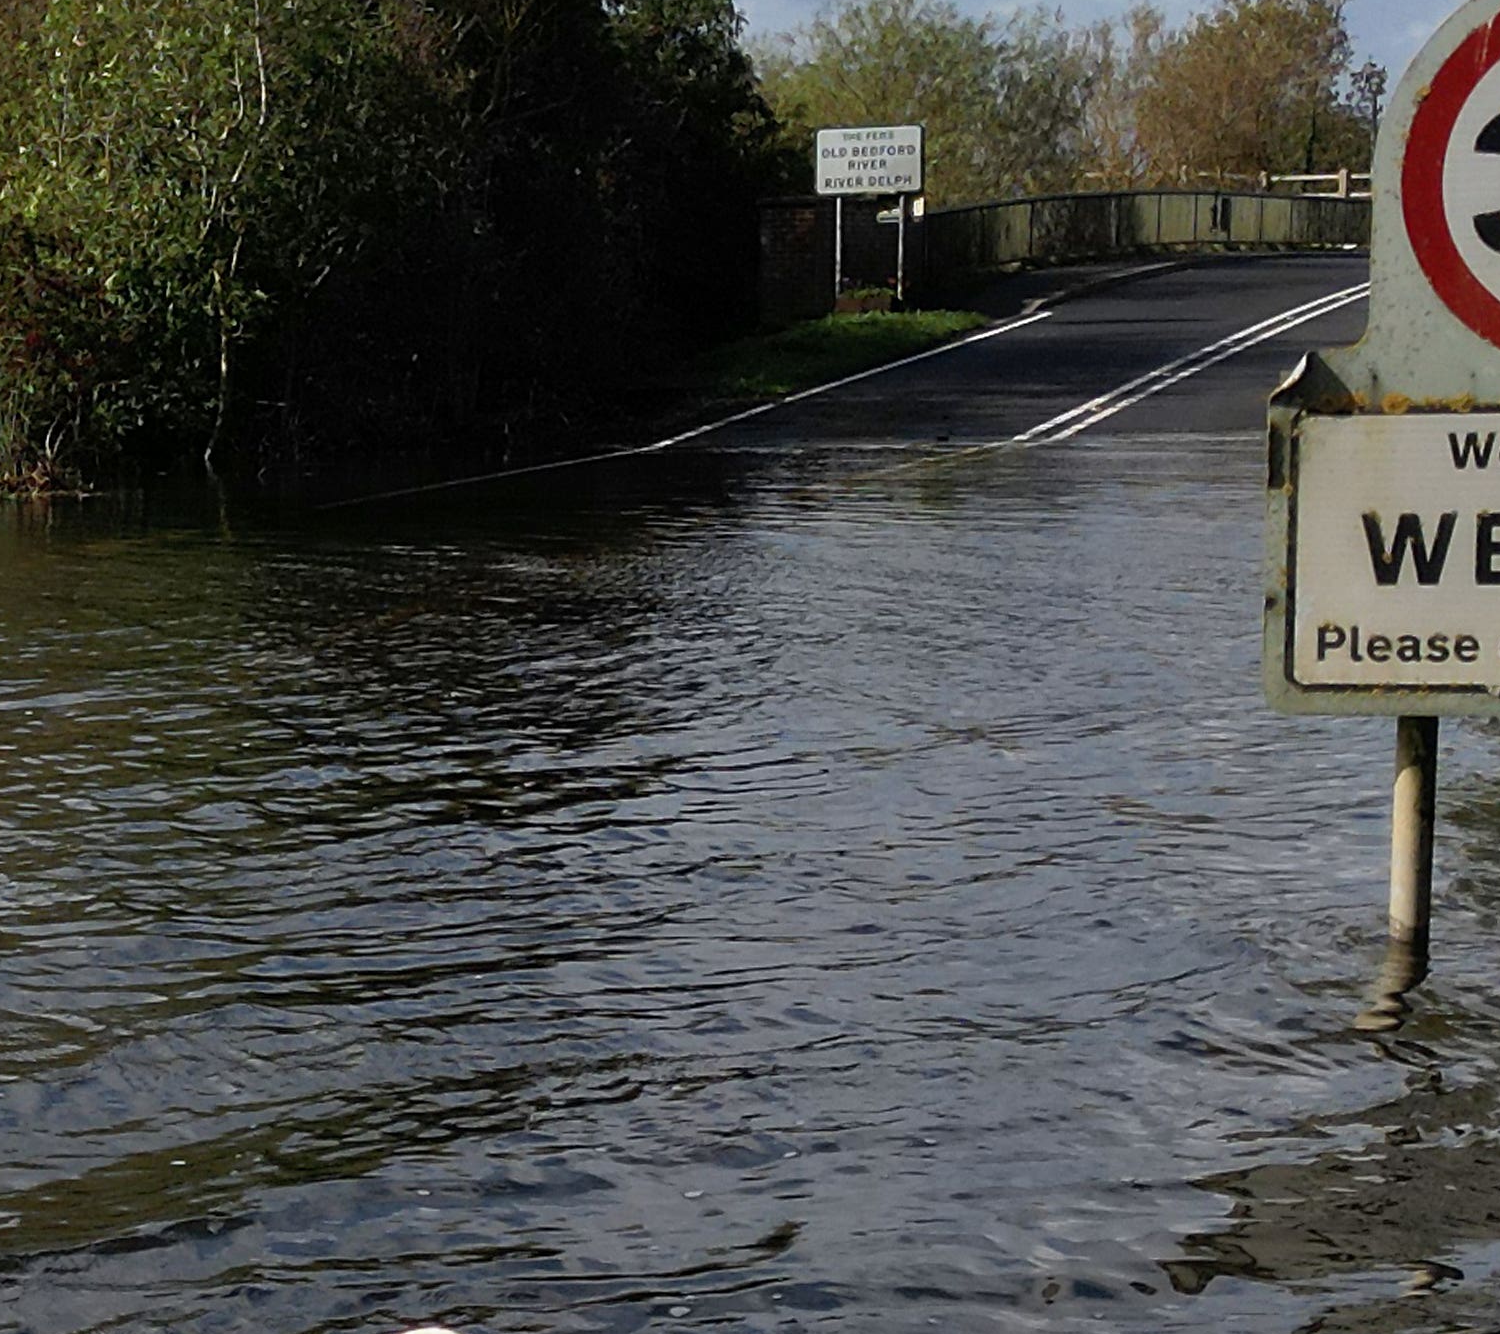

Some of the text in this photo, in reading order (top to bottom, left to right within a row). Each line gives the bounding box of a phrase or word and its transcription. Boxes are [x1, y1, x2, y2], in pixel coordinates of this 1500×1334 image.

[822, 145, 916, 158] OLD BEDFORD
[848, 159, 887, 170] RIVER
[825, 175, 912, 188] RIVER DELPH
[1316, 625, 1480, 663] Please
